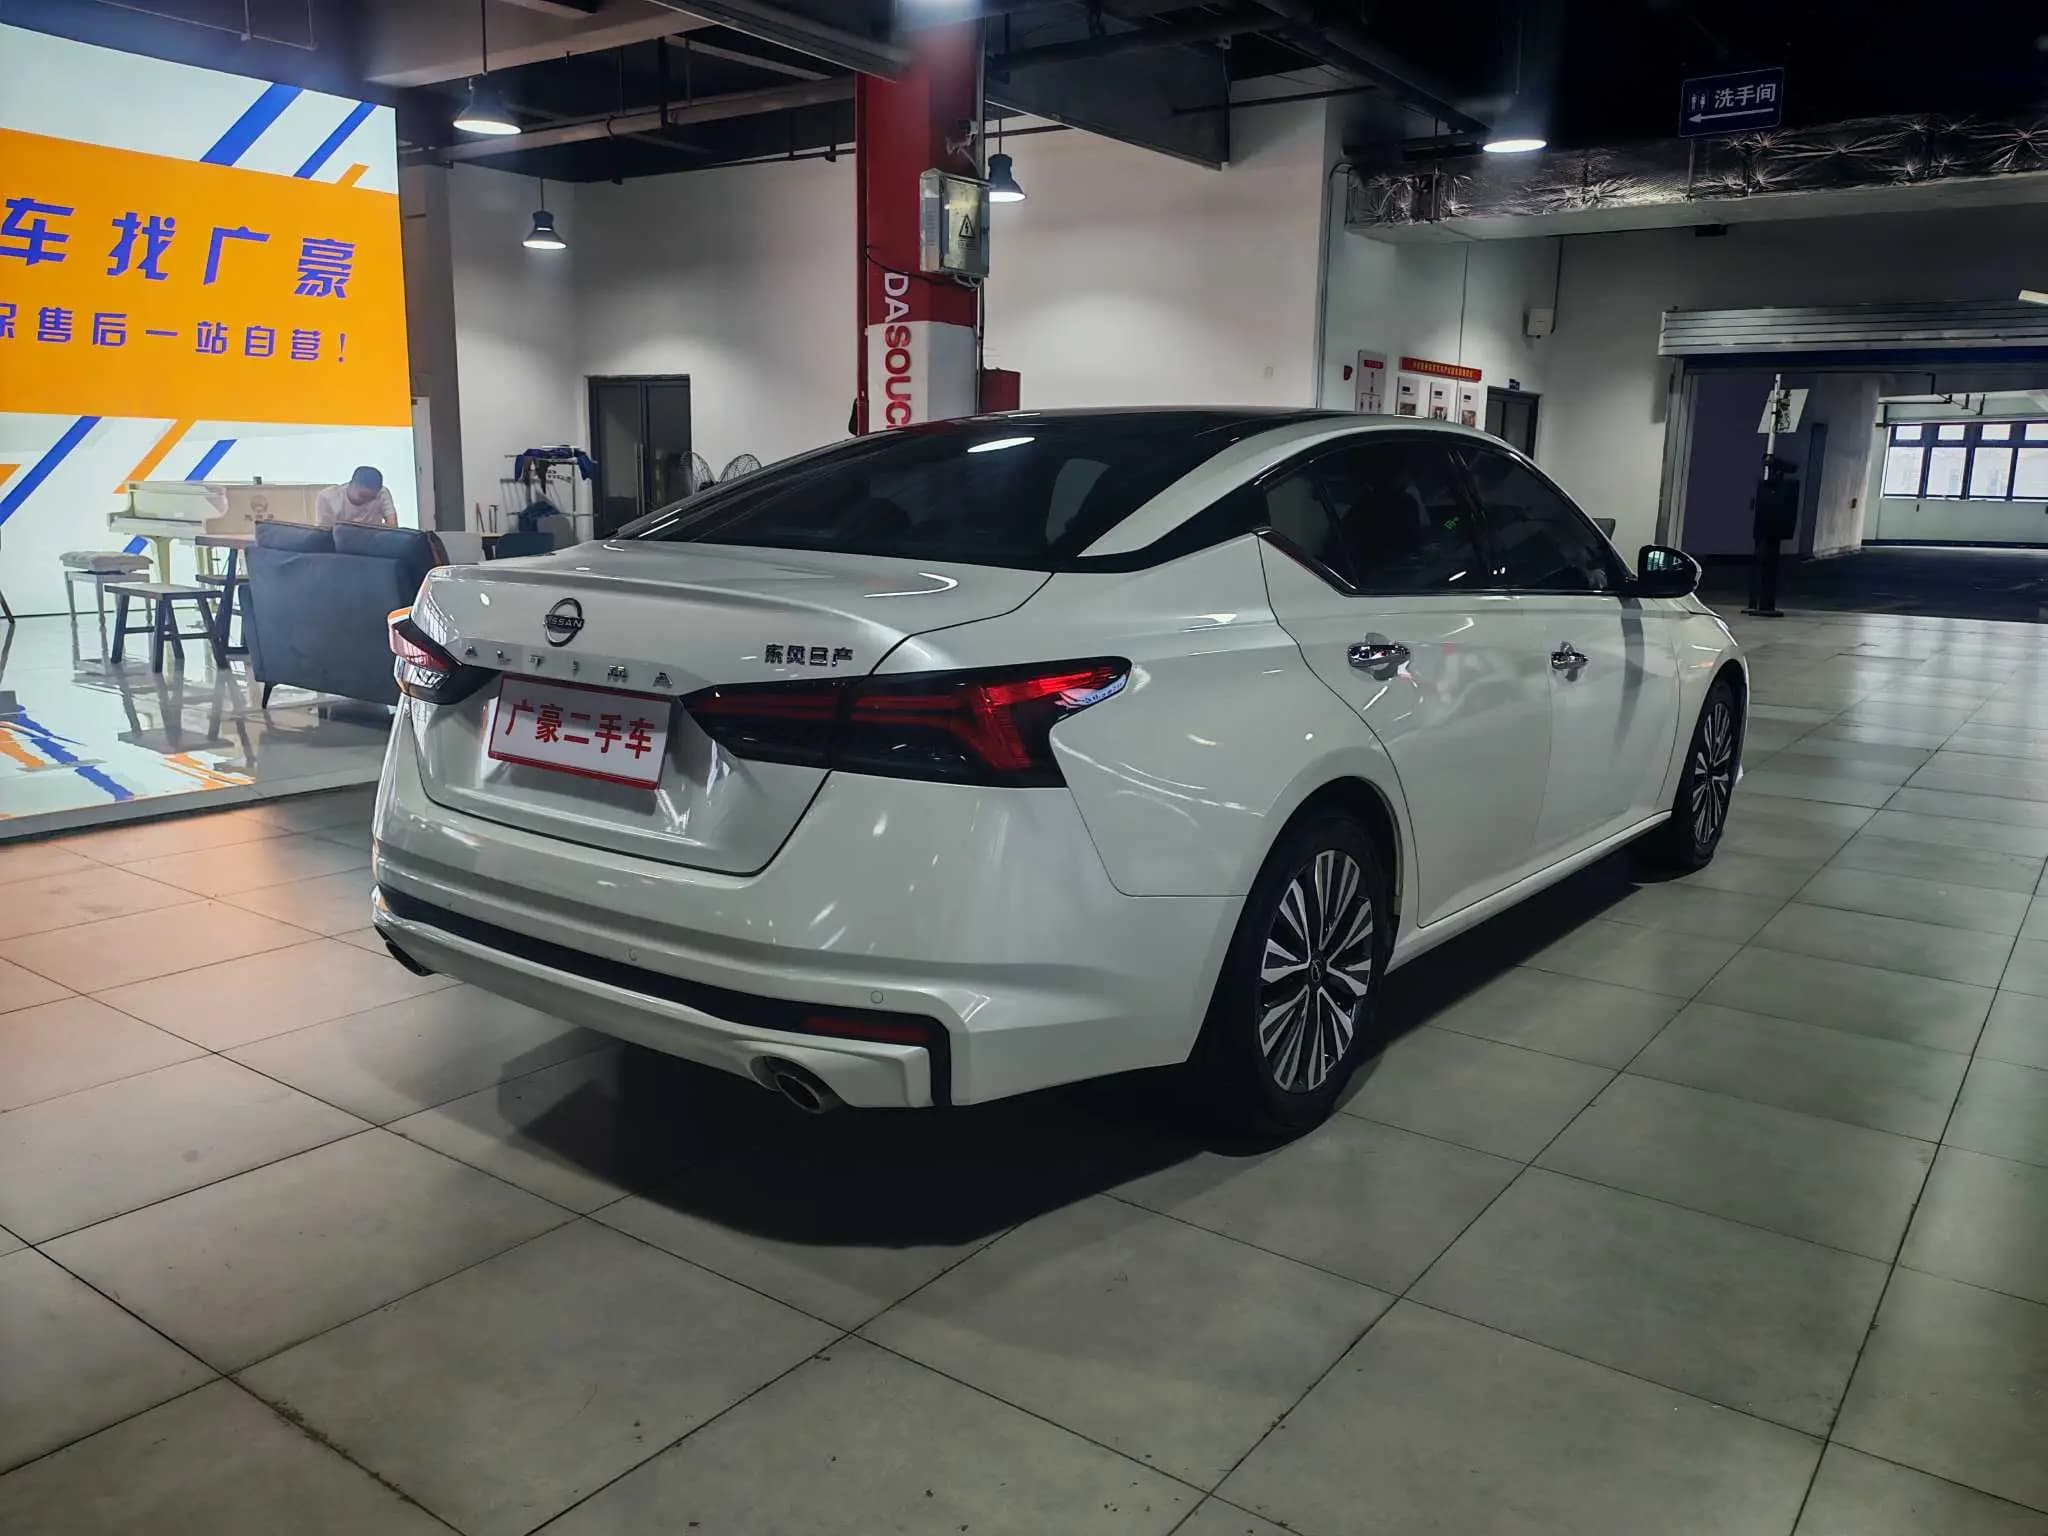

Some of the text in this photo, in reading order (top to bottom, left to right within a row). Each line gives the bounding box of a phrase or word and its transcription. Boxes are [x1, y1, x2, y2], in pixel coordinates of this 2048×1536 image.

[1714, 83, 1777, 109] 洗手间
[0, 197, 356, 299] 车找广豪
[884, 271, 912, 429] DASOUC
[764, 644, 853, 667] 东风日产
[505, 698, 655, 760] 广豪二手车
